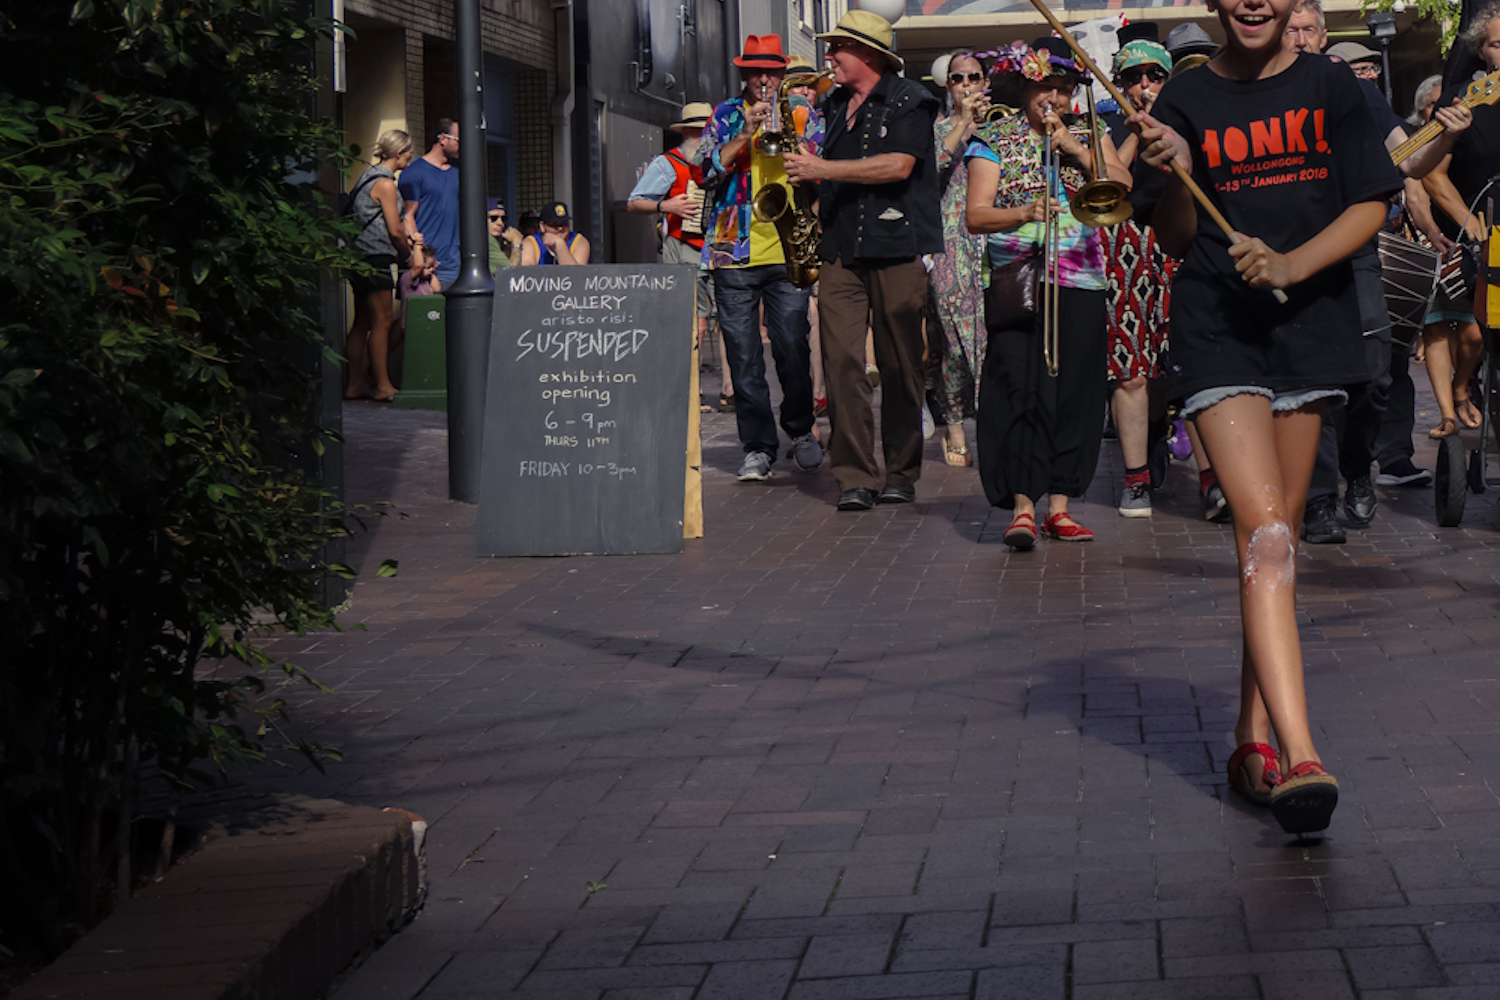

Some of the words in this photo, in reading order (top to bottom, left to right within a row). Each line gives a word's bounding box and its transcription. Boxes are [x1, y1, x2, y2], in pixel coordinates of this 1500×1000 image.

[1231, 156, 1305, 175] WOLLONGONG
[1250, 173, 1298, 188] JANUARY
[1299, 167, 1328, 181] 2018
[509, 275, 572, 293] MOVING
[584, 274, 676, 291] MOUNTAINS
[551, 294, 627, 311] GALLERY
[515, 328, 649, 362] SUSPENDED
[538, 369, 638, 384] exhibition
[541, 385, 611, 407] opening
[544, 435, 579, 447] THURS
[519, 459, 571, 478] FRIDAY
